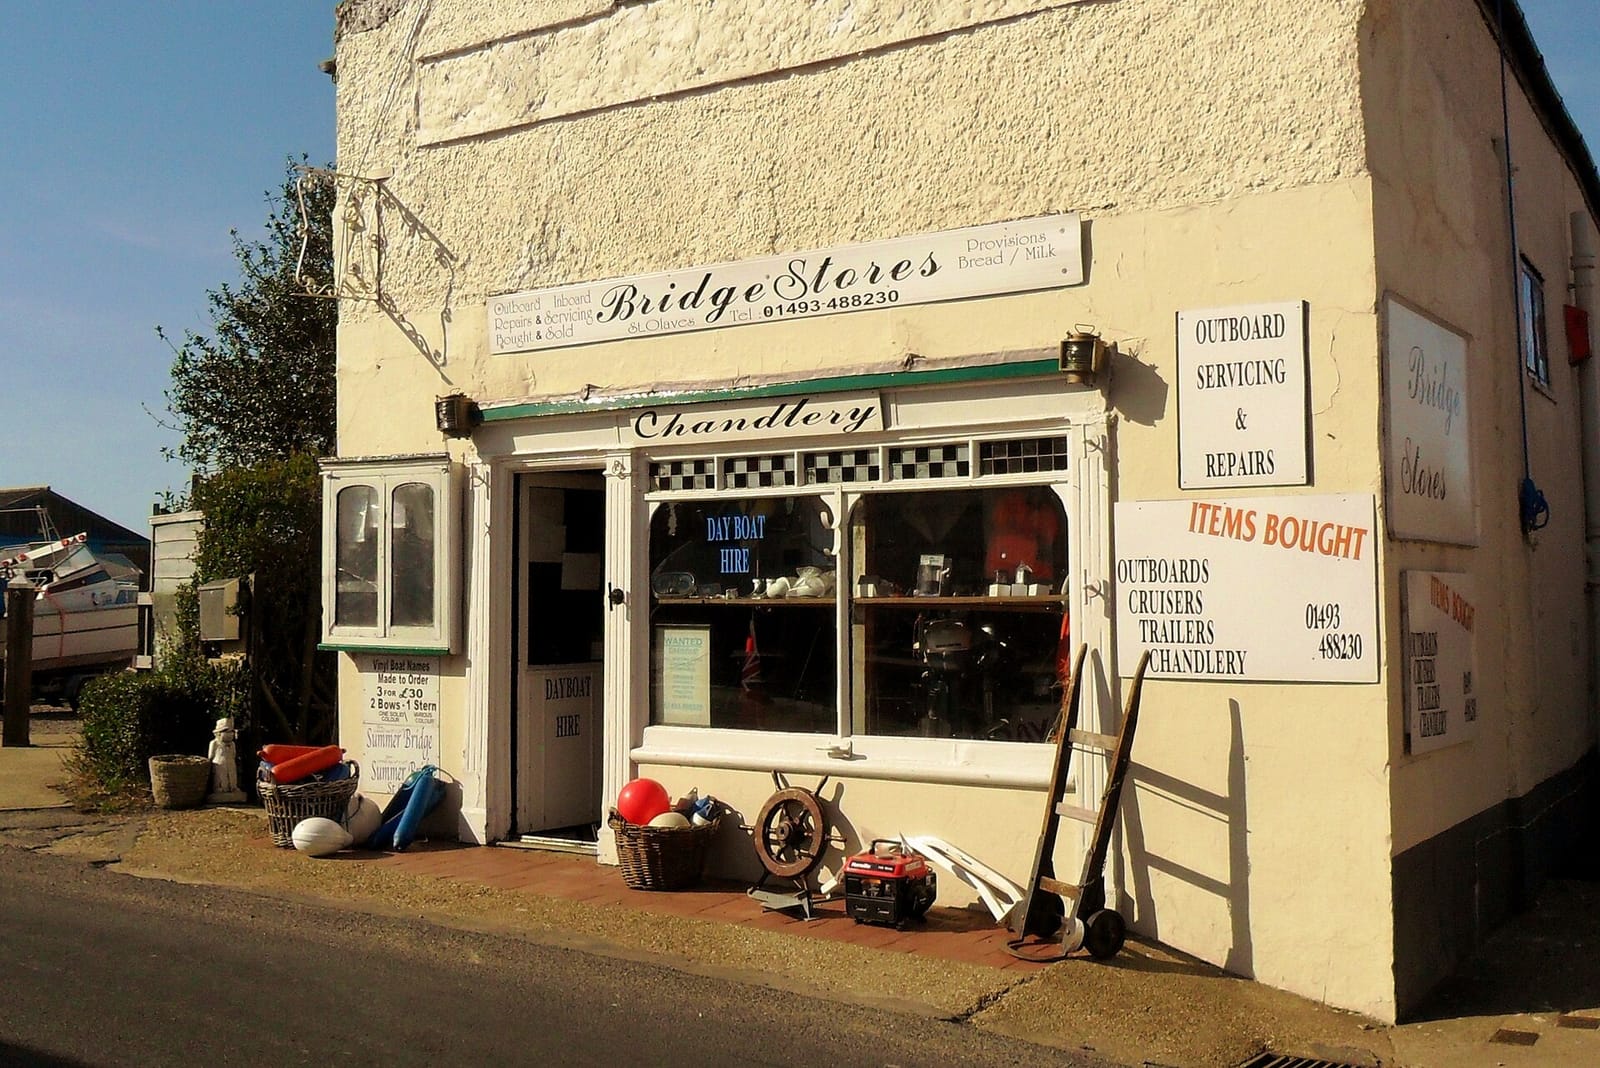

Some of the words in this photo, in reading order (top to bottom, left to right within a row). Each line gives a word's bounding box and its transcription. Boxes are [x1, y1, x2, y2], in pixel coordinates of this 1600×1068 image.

[966, 232, 1047, 253] Provisions
[957, 253, 1003, 269] Bread
[596, 273, 766, 323] Bridge
[773, 251, 942, 300] Stores
[493, 297, 541, 316] Outboard
[553, 289, 591, 308] Inboard
[494, 315, 532, 333] Repairs
[535, 314, 541, 325] &
[544, 307, 594, 326] Servicing
[1196, 313, 1285, 345] OUTBOARD
[496, 330, 532, 349] Bought
[535, 330, 541, 341] &
[545, 322, 574, 340] Sold
[1196, 358, 1286, 390] SERVICING
[1408, 345, 1460, 435] Bridge
[635, 398, 877, 439] Chandlery
[1235, 407, 1247, 431] &
[1205, 449, 1275, 478] REPAIRS
[1401, 436, 1446, 501] Stores
[706, 515, 732, 541] DAY
[734, 514, 766, 539] BOAT
[1188, 501, 1257, 542] ITEMS
[1263, 513, 1368, 560] BOUGHT
[720, 548, 749, 573] HIRE
[1117, 558, 1210, 584] OUTBOARDS
[1128, 589, 1203, 615] CRUISERS
[1305, 603, 1340, 630] 01493
[665, 637, 703, 646] WANTED
[1139, 619, 1214, 645] TRAILERS
[1318, 633, 1362, 660] 488230
[373, 660, 389, 673] Vinyl
[390, 660, 406, 672] Boat
[407, 662, 430, 672] Names
[1149, 648, 1247, 675] CHANDLERY
[376, 686, 383, 697] 3
[399, 688, 423, 698] £30
[378, 674, 396, 684] Made
[399, 674, 406, 684] to
[408, 674, 429, 685] Order
[370, 698, 375, 708] 2
[377, 699, 400, 710] Bows
[406, 700, 411, 710] 1
[413, 700, 437, 711] Stern
[556, 714, 580, 737] HIRE
[366, 727, 401, 749] Summer
[403, 726, 433, 760] Bridge
[370, 760, 406, 781] Summer
